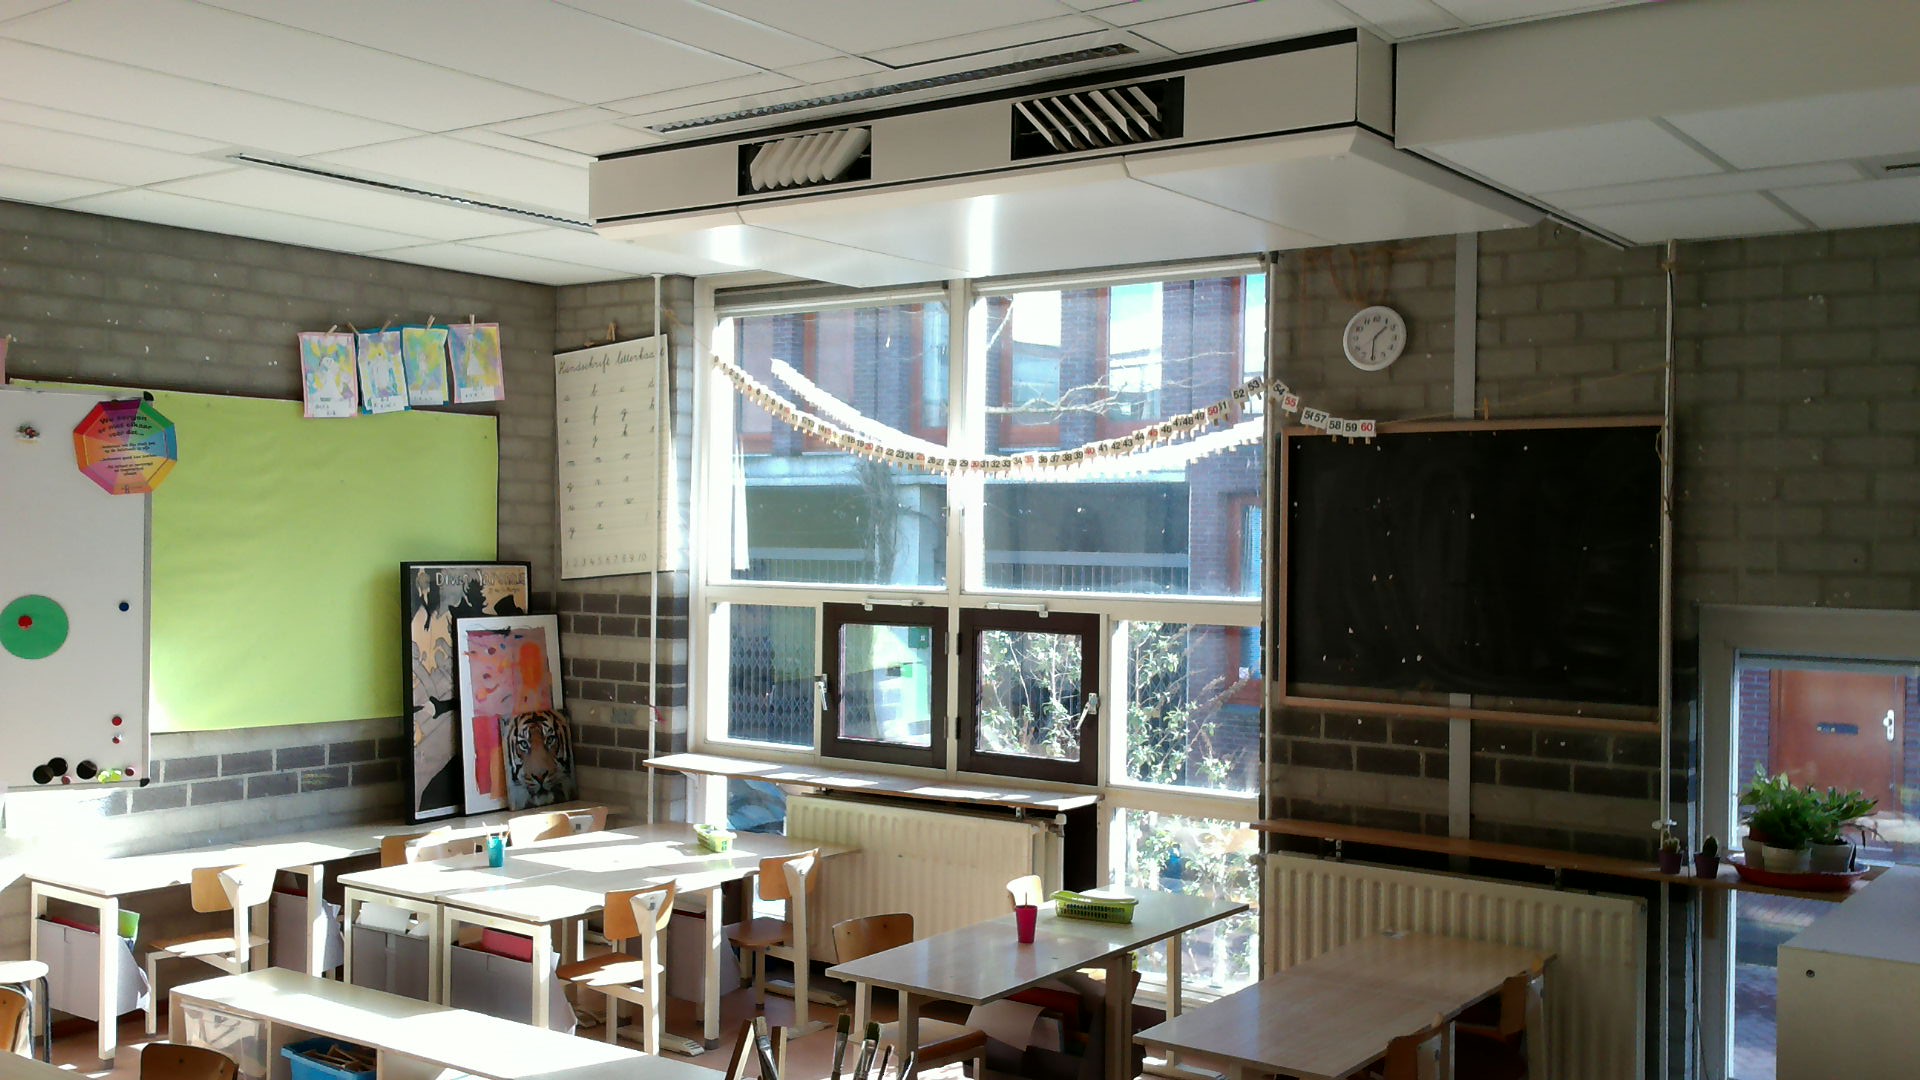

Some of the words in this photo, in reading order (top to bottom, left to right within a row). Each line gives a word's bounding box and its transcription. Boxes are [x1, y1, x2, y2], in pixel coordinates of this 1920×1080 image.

[990, 460, 1000, 468] 32
[1050, 454, 1060, 463] 37
[1062, 453, 1072, 462] 38
[1111, 440, 1121, 450] 42
[1123, 438, 1133, 448] 43
[1183, 415, 1194, 426] 48
[1194, 412, 1205, 421] 49
[1208, 405, 1219, 416] 50
[1233, 388, 1245, 400] 52
[1248, 380, 1260, 391] 53
[1273, 383, 1286, 396] 54
[1284, 396, 1297, 408] 55
[1314, 413, 1326, 424] 57
[1330, 420, 1341, 430] 58
[1345, 422, 1358, 432] 59
[1361, 422, 1373, 432] 60
